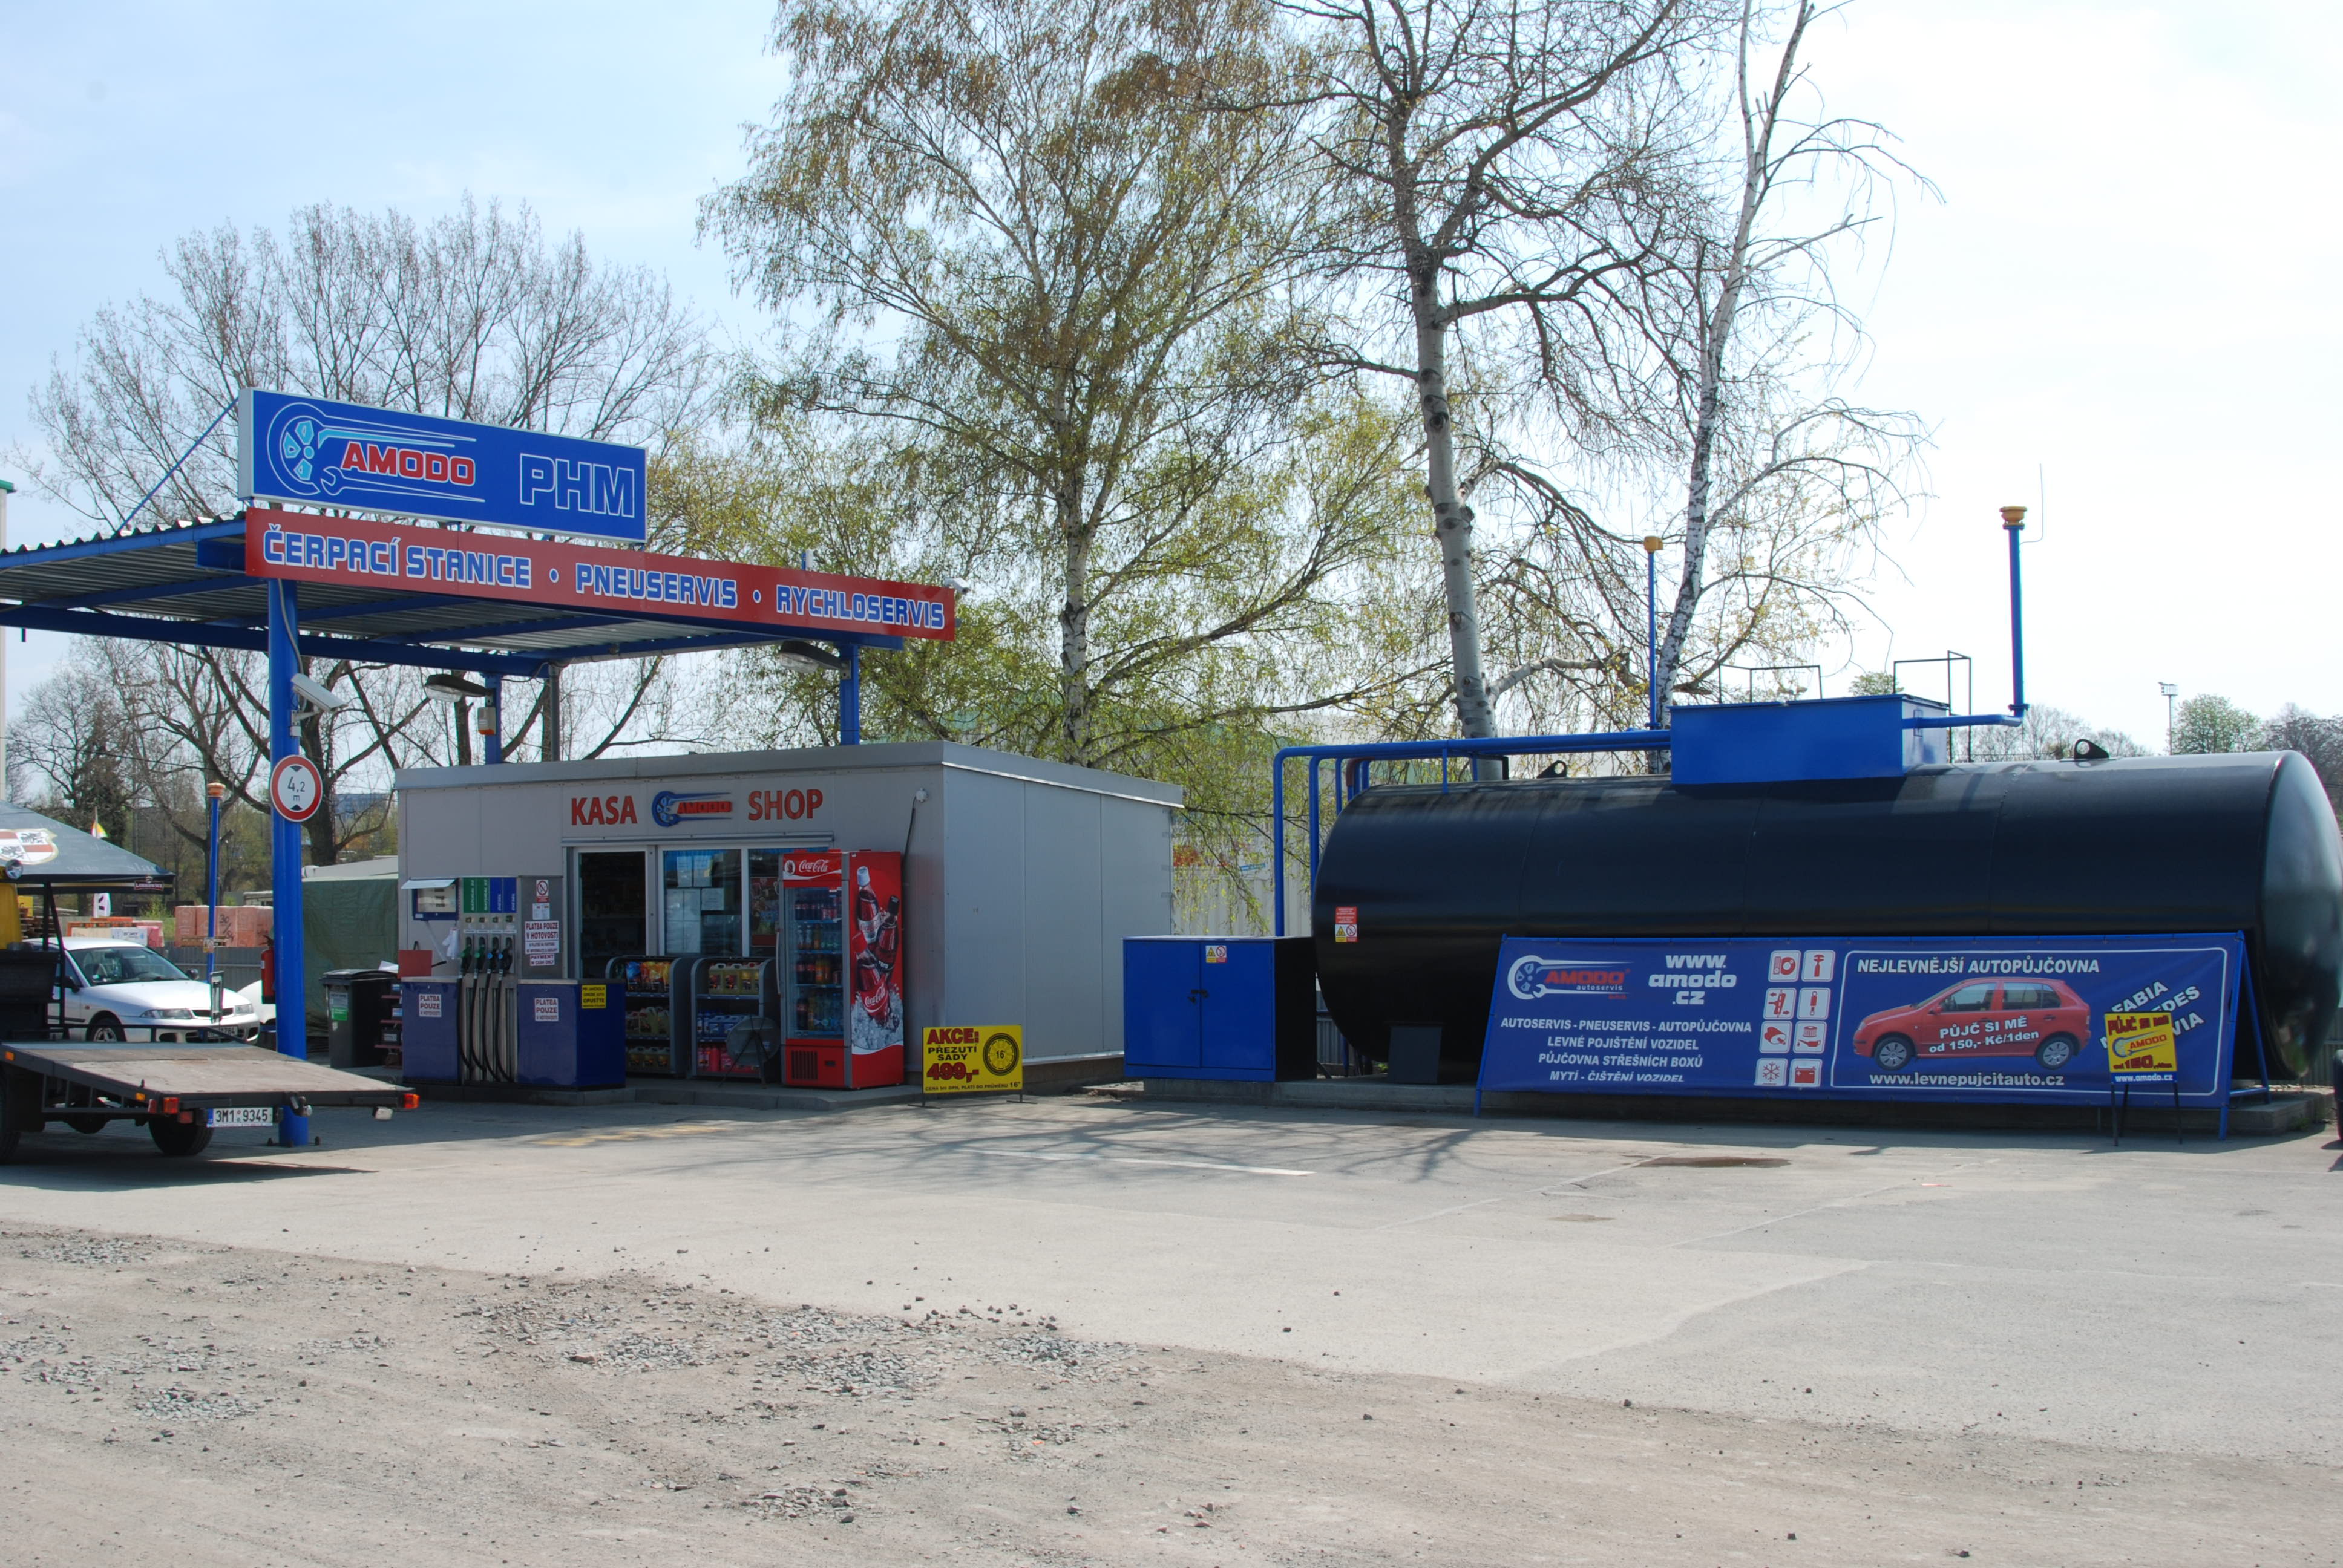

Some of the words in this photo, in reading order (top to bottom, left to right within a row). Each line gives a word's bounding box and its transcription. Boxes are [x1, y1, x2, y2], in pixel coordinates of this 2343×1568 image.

[342, 442, 476, 486] AMODO
[520, 453, 635, 518] PHM
[264, 524, 401, 575] ČERPACÍ
[406, 544, 531, 589] STANICE
[576, 563, 738, 609] PNEUSERVIS
[776, 584, 945, 630] RYCHLOSERVIS
[287, 776, 306, 792] 4,2
[571, 795, 638, 826] KASA
[677, 801, 733, 814] AMODO
[748, 789, 823, 821] SHOP
[1858, 956, 1964, 973] NEJLEVNĚJŠÍ
[1968, 956, 2100, 974] AUTOPŮJČOVNA
[1545, 970, 1625, 985] AMODO
[1648, 970, 1737, 988] amodo
[2111, 981, 2169, 1012] FABIA
[1501, 1018, 1571, 1030] AUTOSERVIS
[1578, 1020, 1650, 1031] PNEUSERVIS
[1658, 1018, 1752, 1033] AUTOPŮJČOVNA
[1939, 1021, 1982, 1039] PŮJČ
[1985, 1020, 1999, 1032] SI
[2000, 1016, 2027, 1030] MĚ
[928, 1044, 977, 1054] PŘEZUTÍ
[1547, 1035, 1585, 1047] LEVNÉ
[1587, 1035, 1648, 1049] POJIŠTĚNÍ
[1651, 1039, 1699, 1050] VOZIDEL
[1928, 1042, 1945, 1054] od
[1949, 1037, 1982, 1051] 150,-
[2130, 1034, 2167, 1049] AMODO
[997, 1050, 1006, 1059] 16
[1538, 1051, 1600, 1065] PŮJČOVNA
[1602, 1053, 1668, 1068] STŘEŠNÍCH
[1671, 1054, 1703, 1068] BOXŮ
[926, 1062, 979, 1083] 499,-
[1550, 1069, 1579, 1082] MYTÍ
[1587, 1070, 1633, 1082] ČIŠTĚNÍ
[1636, 1073, 1685, 1083] VOZIDEL
[1869, 1071, 2065, 1087] www.levnepujcitauto.cz
[2115, 1073, 2173, 1082] www.amodo.cz
[216, 1110, 234, 1123] 3M1
[243, 1109, 268, 1122] 9345
